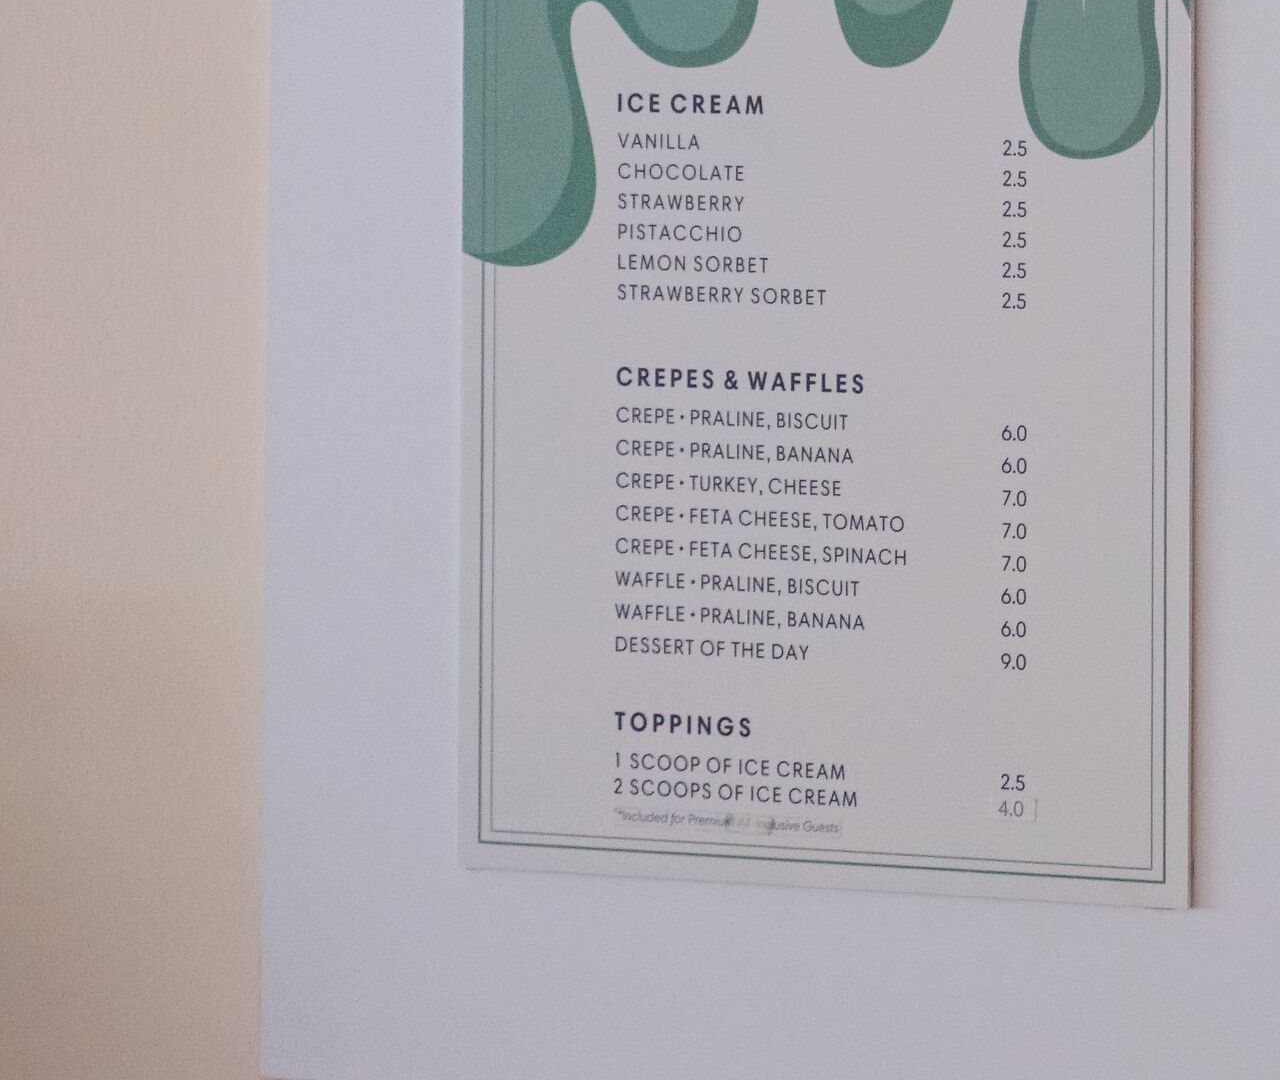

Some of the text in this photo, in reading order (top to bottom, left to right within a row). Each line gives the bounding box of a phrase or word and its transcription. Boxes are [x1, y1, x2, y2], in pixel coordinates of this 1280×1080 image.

[618, 93, 763, 114] ICE CREAM
[618, 133, 699, 150] VANILLA
[1003, 140, 1027, 157] 2.5
[618, 163, 743, 181] CHOCOLATE
[1003, 170, 1027, 187] 2.5
[618, 193, 744, 211] STRAWBERRY
[1003, 201, 1027, 218] 2.5
[618, 223, 742, 243] PISTACCHIO
[1003, 231, 1026, 248] 2.5
[618, 254, 768, 273] LEMON SORBET
[1002, 262, 1026, 279] 2.5
[618, 284, 826, 305] STRAWBERRY SORBET
[1002, 292, 1026, 309] 2.5
[616, 367, 863, 394] CREPES & WAFFLES
[616, 406, 848, 430] CREPE PRALINE, BISCUIT
[1001, 425, 1027, 441] 6.0
[616, 439, 853, 463] CREPE PRALINE, BANANA
[1001, 458, 1027, 474] 6.0
[616, 472, 840, 496] CREPE TURKEY, CHEESE
[1003, 490, 1027, 507] 7.0
[616, 505, 904, 532] CREPE FETA CHEESE, TOMATO
[1003, 522, 1027, 540] 7.0
[616, 537, 906, 565] CREPE FETA CHEESE, SPINACH
[1002, 555, 1027, 572] 7.0
[615, 571, 859, 596] WAFFLE PRALINE, BISCUIT
[1001, 588, 1026, 605] 6.0
[615, 604, 865, 630] WAFFLE PRALINE, BANANA
[1001, 621, 1026, 638] 6.0
[615, 636, 808, 660] DESSERT OF THE DAY
[1001, 653, 1026, 670] 9.0
[615, 712, 750, 737] TOPPINGS
[616, 752, 845, 780] 1 SCOOP OF ICE CREAM
[1001, 773, 1025, 791] 2.5
[614, 778, 857, 807] 2 SCOOPS OF ICE CREAM
[998, 801, 1024, 817] 4.0
[802, 820, 840, 833] Guests
